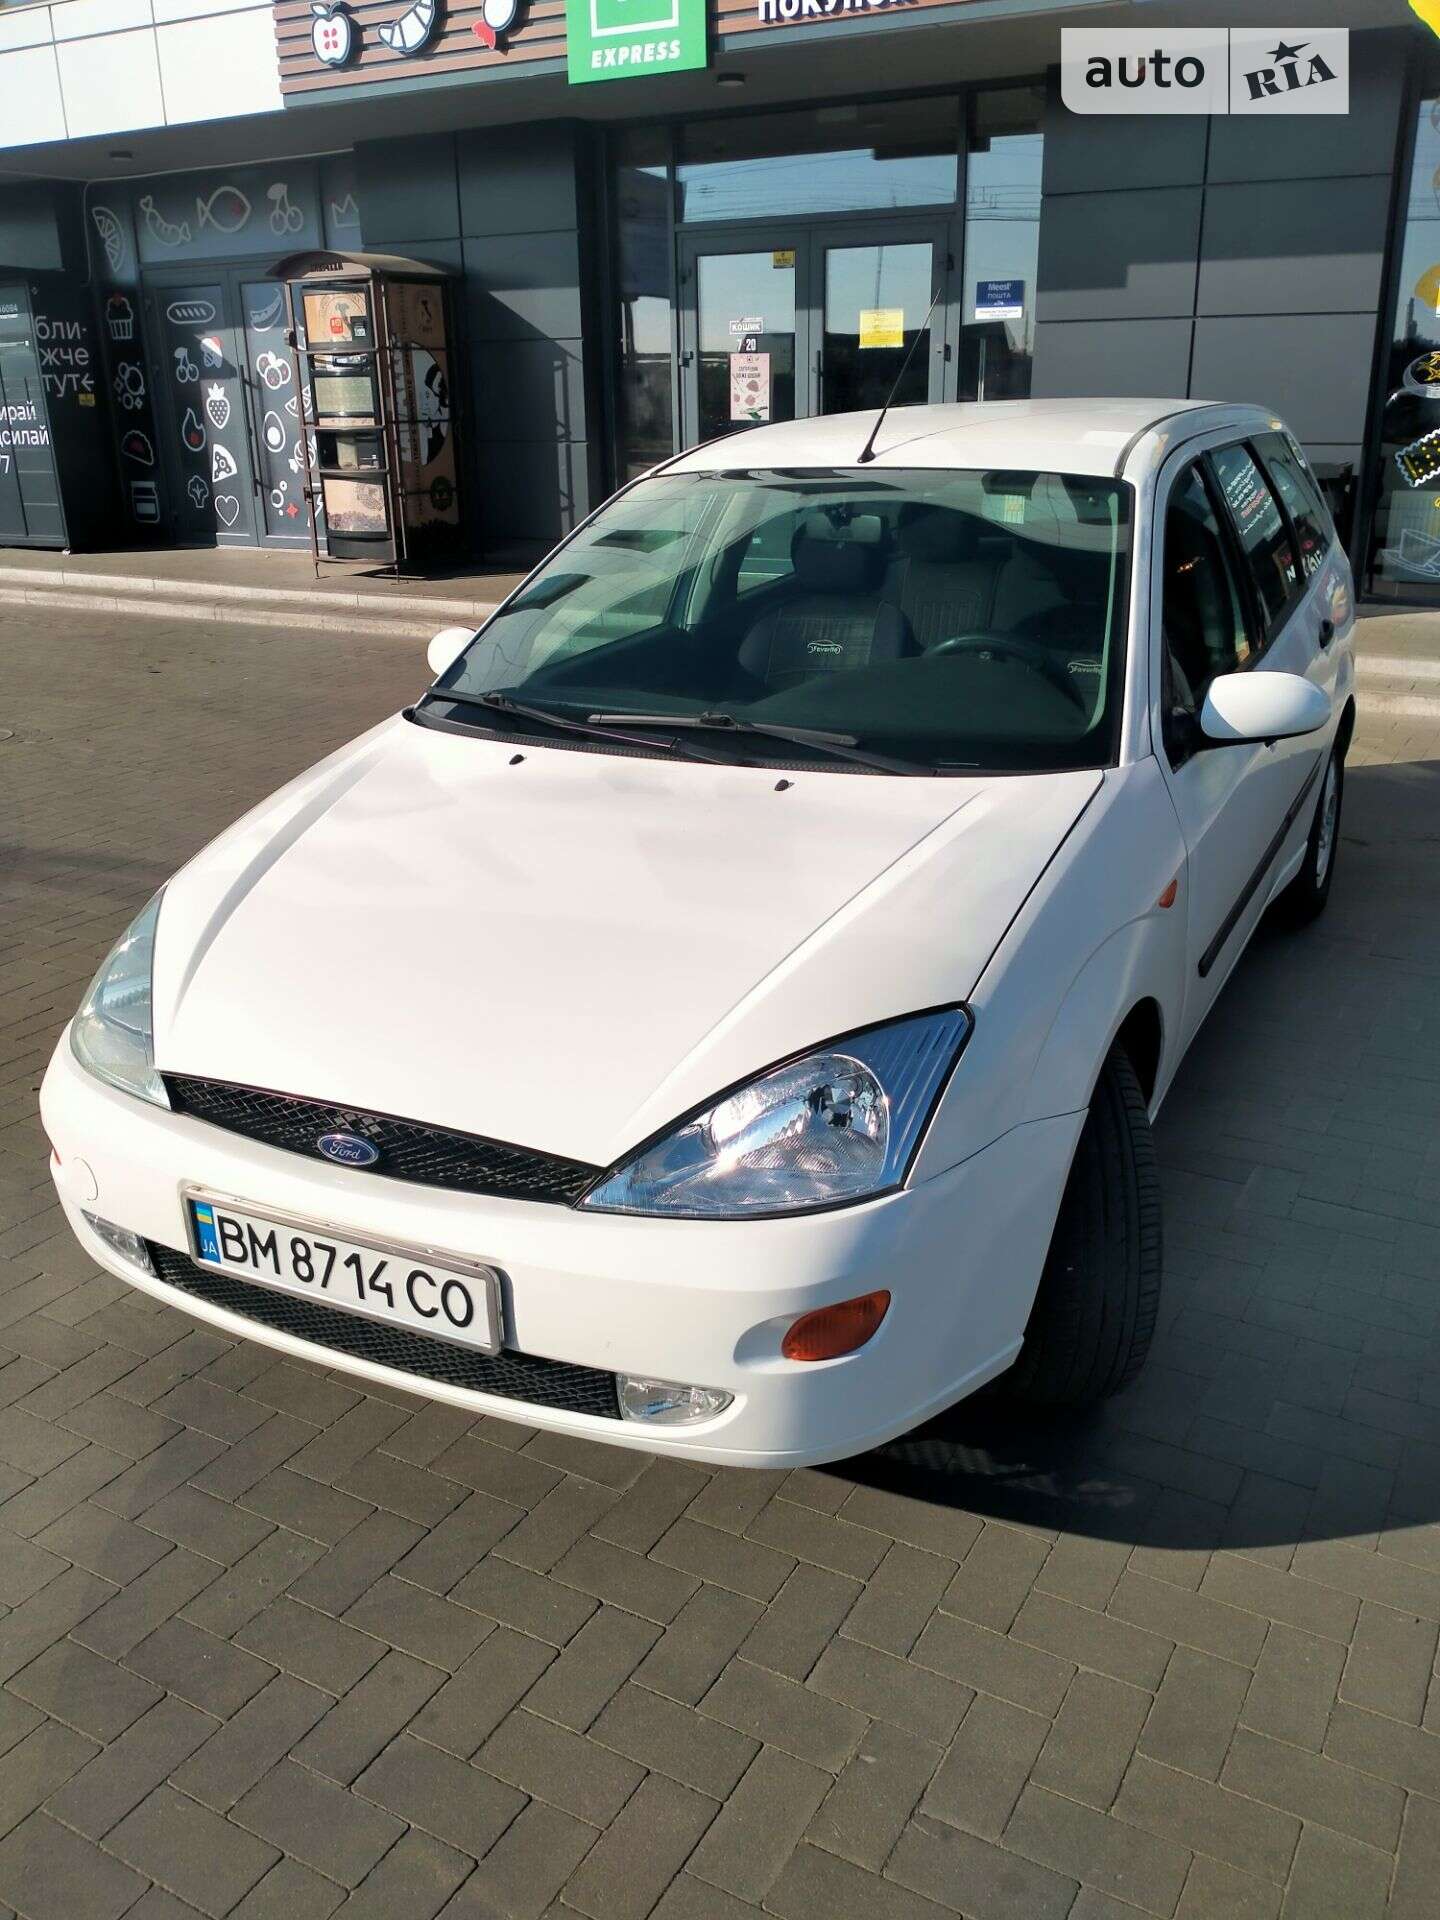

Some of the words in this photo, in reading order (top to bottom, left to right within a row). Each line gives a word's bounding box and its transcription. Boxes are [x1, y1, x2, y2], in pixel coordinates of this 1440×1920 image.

[591, 40, 681, 69] EXPRESS
[39, 347, 89, 366] жче
[41, 373, 80, 398] тут
[330, 1140, 361, 1160] Ford
[217, 1215, 281, 1275] BM
[290, 1237, 395, 1308] 8714
[406, 1269, 475, 1328] CO
